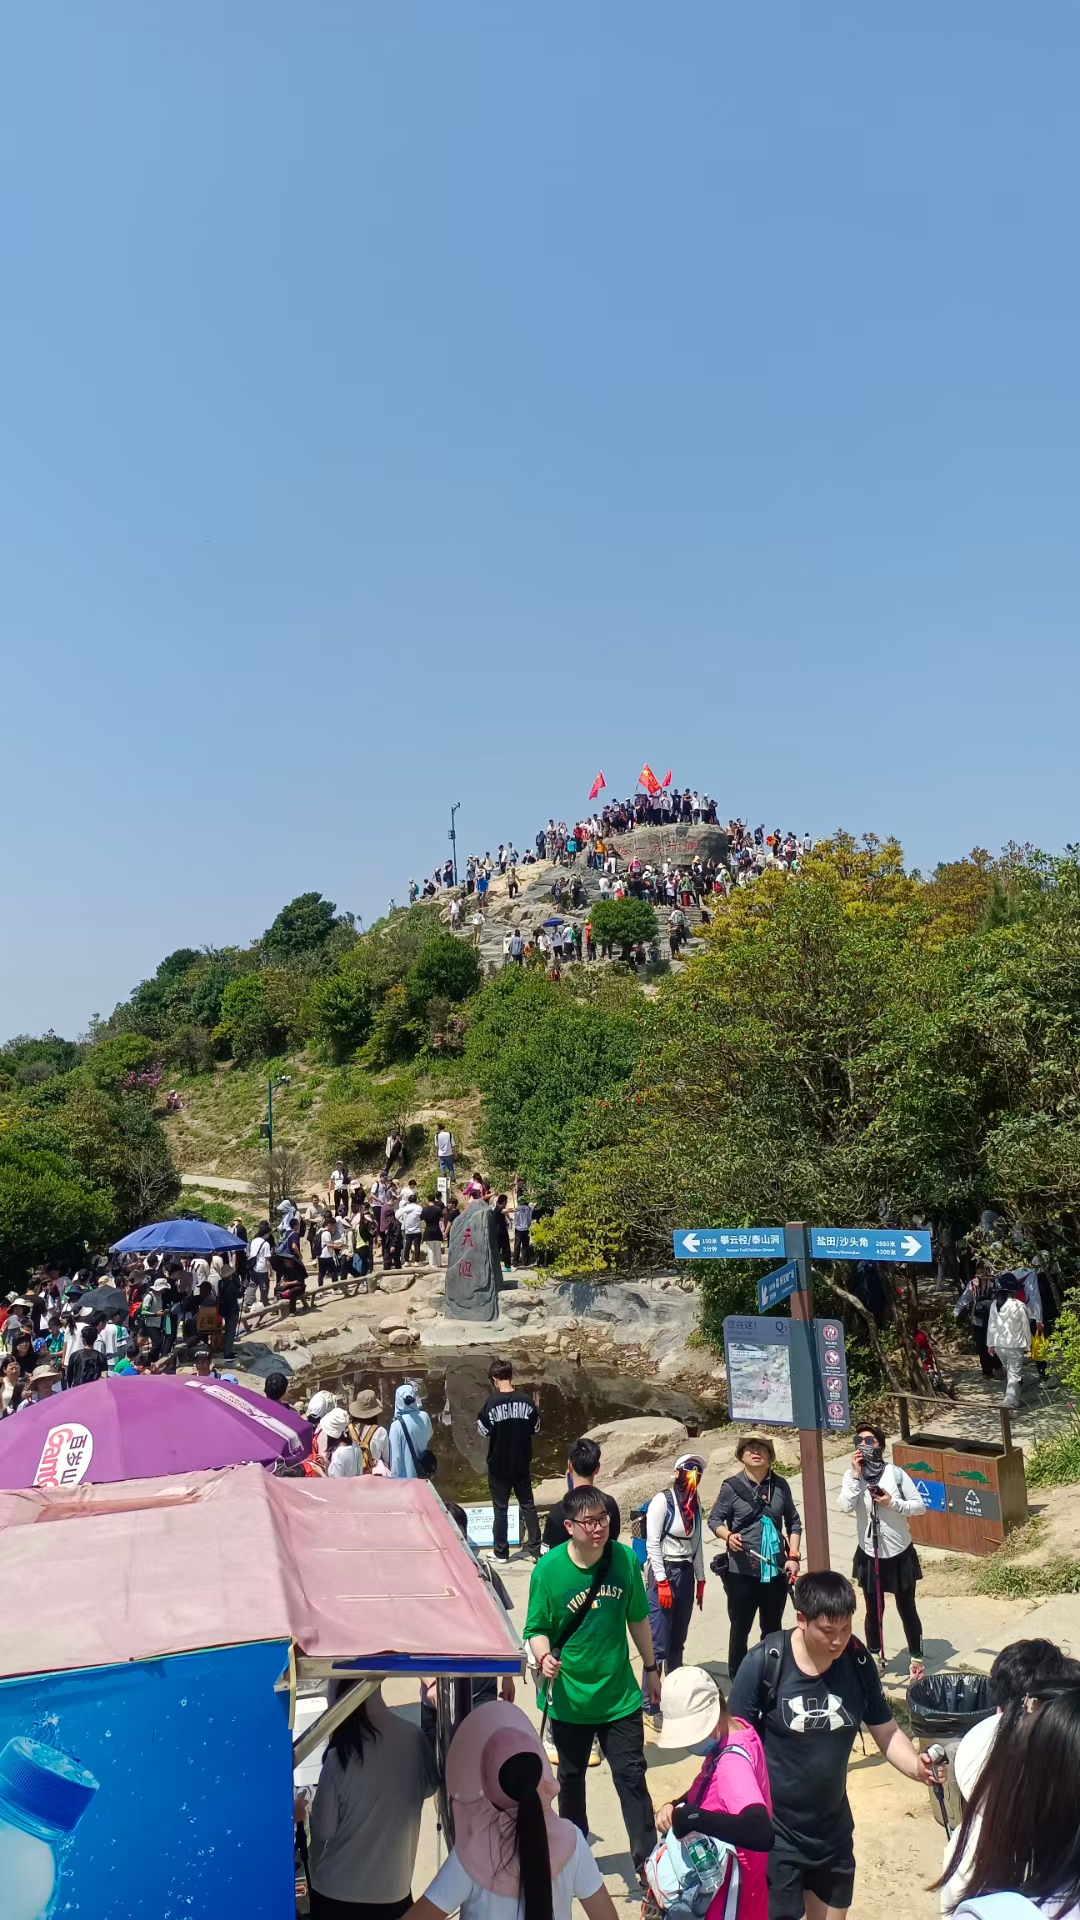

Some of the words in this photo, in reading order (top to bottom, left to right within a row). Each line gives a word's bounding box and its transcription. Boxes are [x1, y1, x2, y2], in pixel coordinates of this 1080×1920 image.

[816, 1235, 869, 1248] 盐田/沙头角
[60, 1434, 88, 1484] 百岁山
[596, 1584, 624, 1600] OAST
